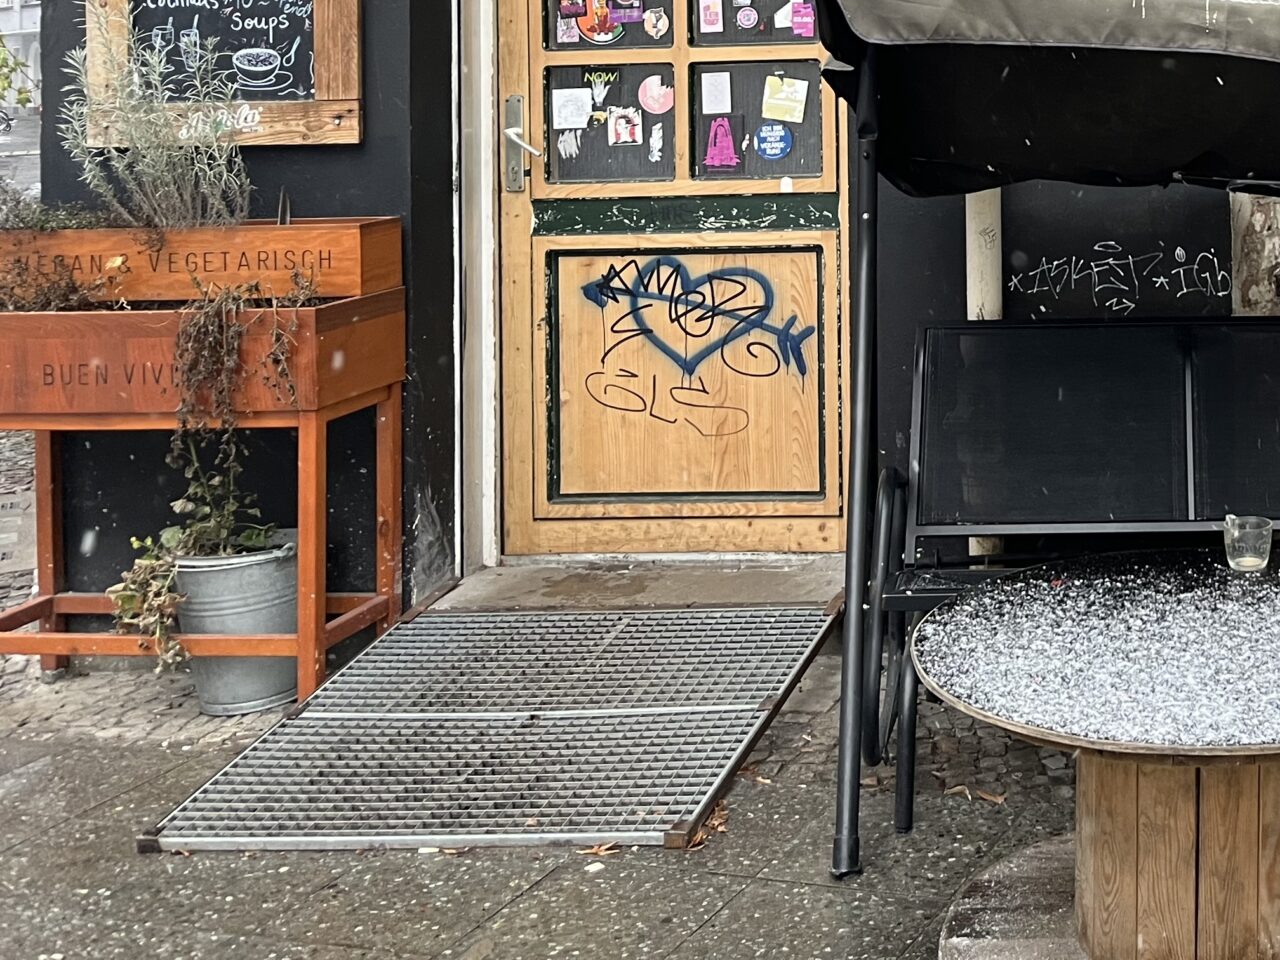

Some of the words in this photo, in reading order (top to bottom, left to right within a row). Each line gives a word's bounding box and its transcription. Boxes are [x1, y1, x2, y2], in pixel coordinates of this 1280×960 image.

[230, 12, 290, 43] Soups
[148, 248, 333, 274] VEGETARISCH
[43, 363, 108, 386] BUEN
